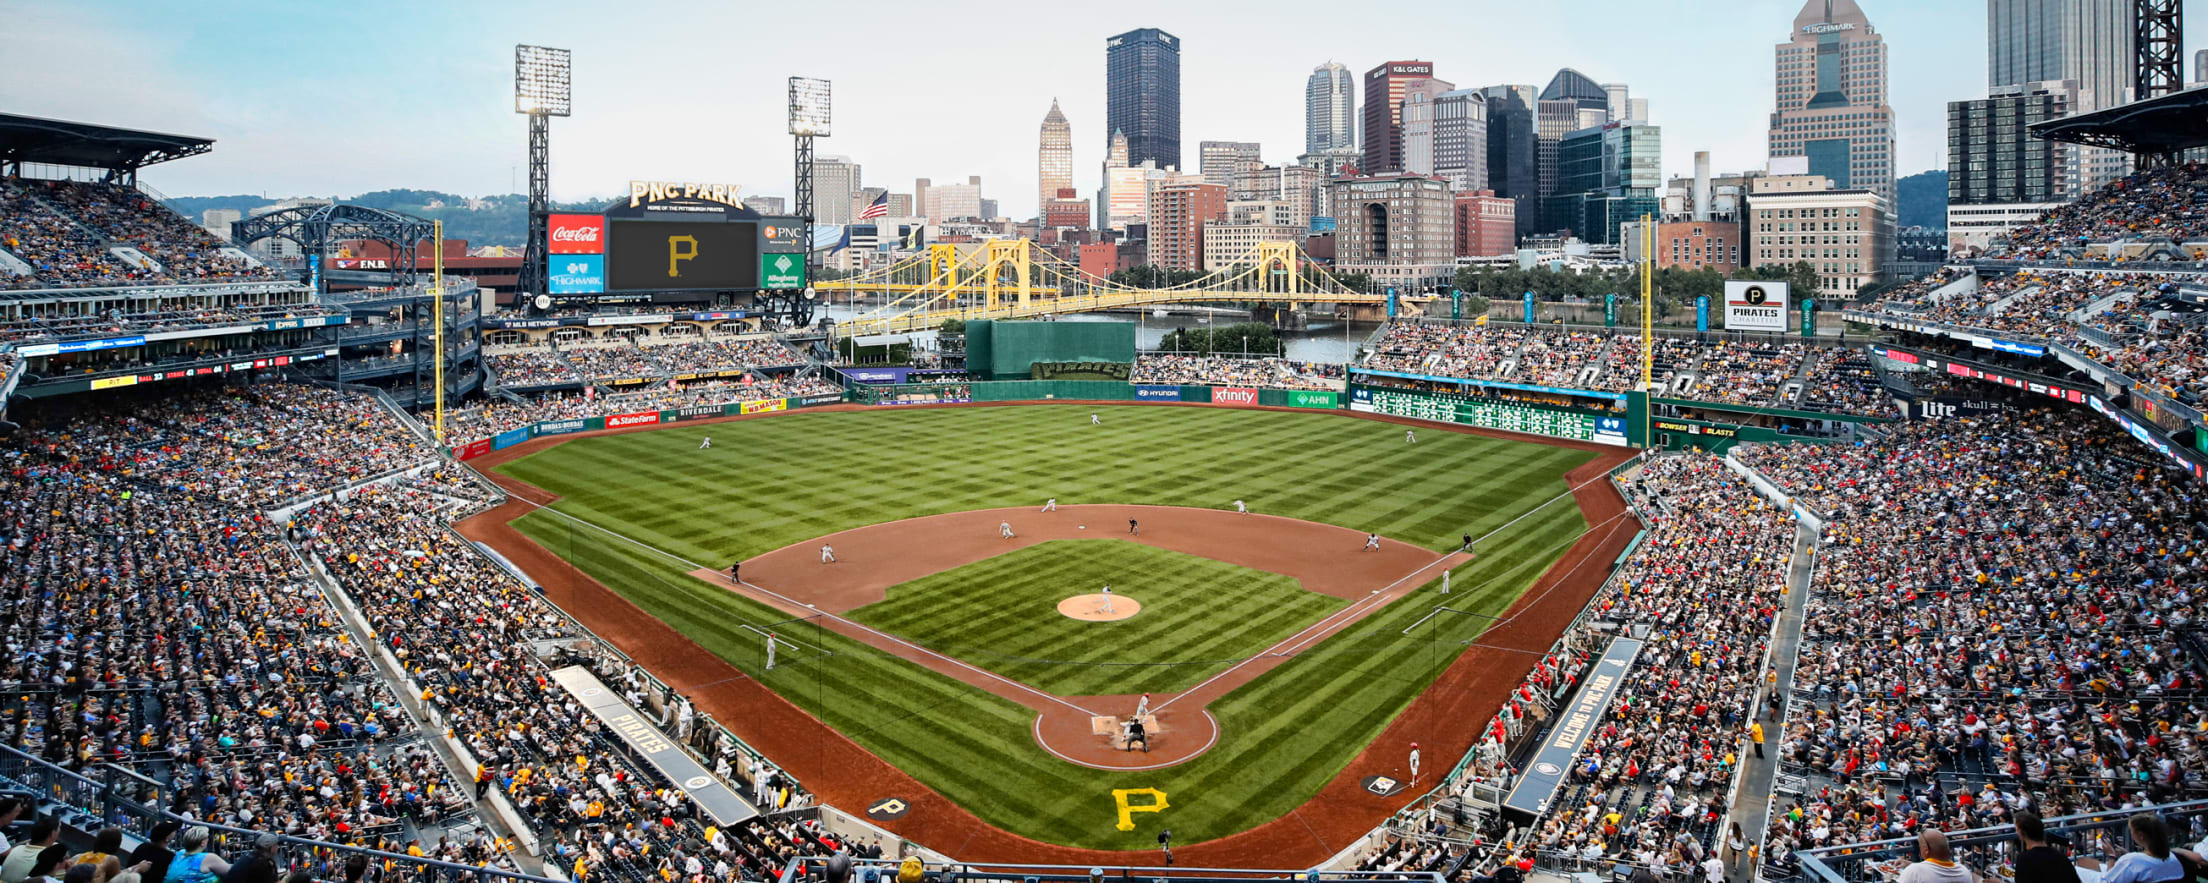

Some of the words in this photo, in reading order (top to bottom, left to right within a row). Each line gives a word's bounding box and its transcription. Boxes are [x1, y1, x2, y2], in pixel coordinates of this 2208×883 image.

[630, 180, 680, 208] PNC
[684, 182, 744, 210] PARK
[553, 226, 600, 242] Coca-Cola
[777, 227, 801, 238] PNC
[668, 234, 698, 277] P
[1751, 289, 1761, 303] P
[1733, 308, 1778, 317] PIRATES
[1215, 389, 1254, 404] xfinity
[759, 399, 782, 411] MASON
[1921, 400, 1957, 420] Lite
[1962, 400, 1988, 409] skull
[1660, 422, 1687, 431] BOWSER
[1707, 428, 1735, 436] BLASTS
[611, 714, 670, 754] PIRATES
[1553, 712, 1591, 749] WELCOME
[868, 799, 906, 814] P
[1111, 783, 1171, 831] P
